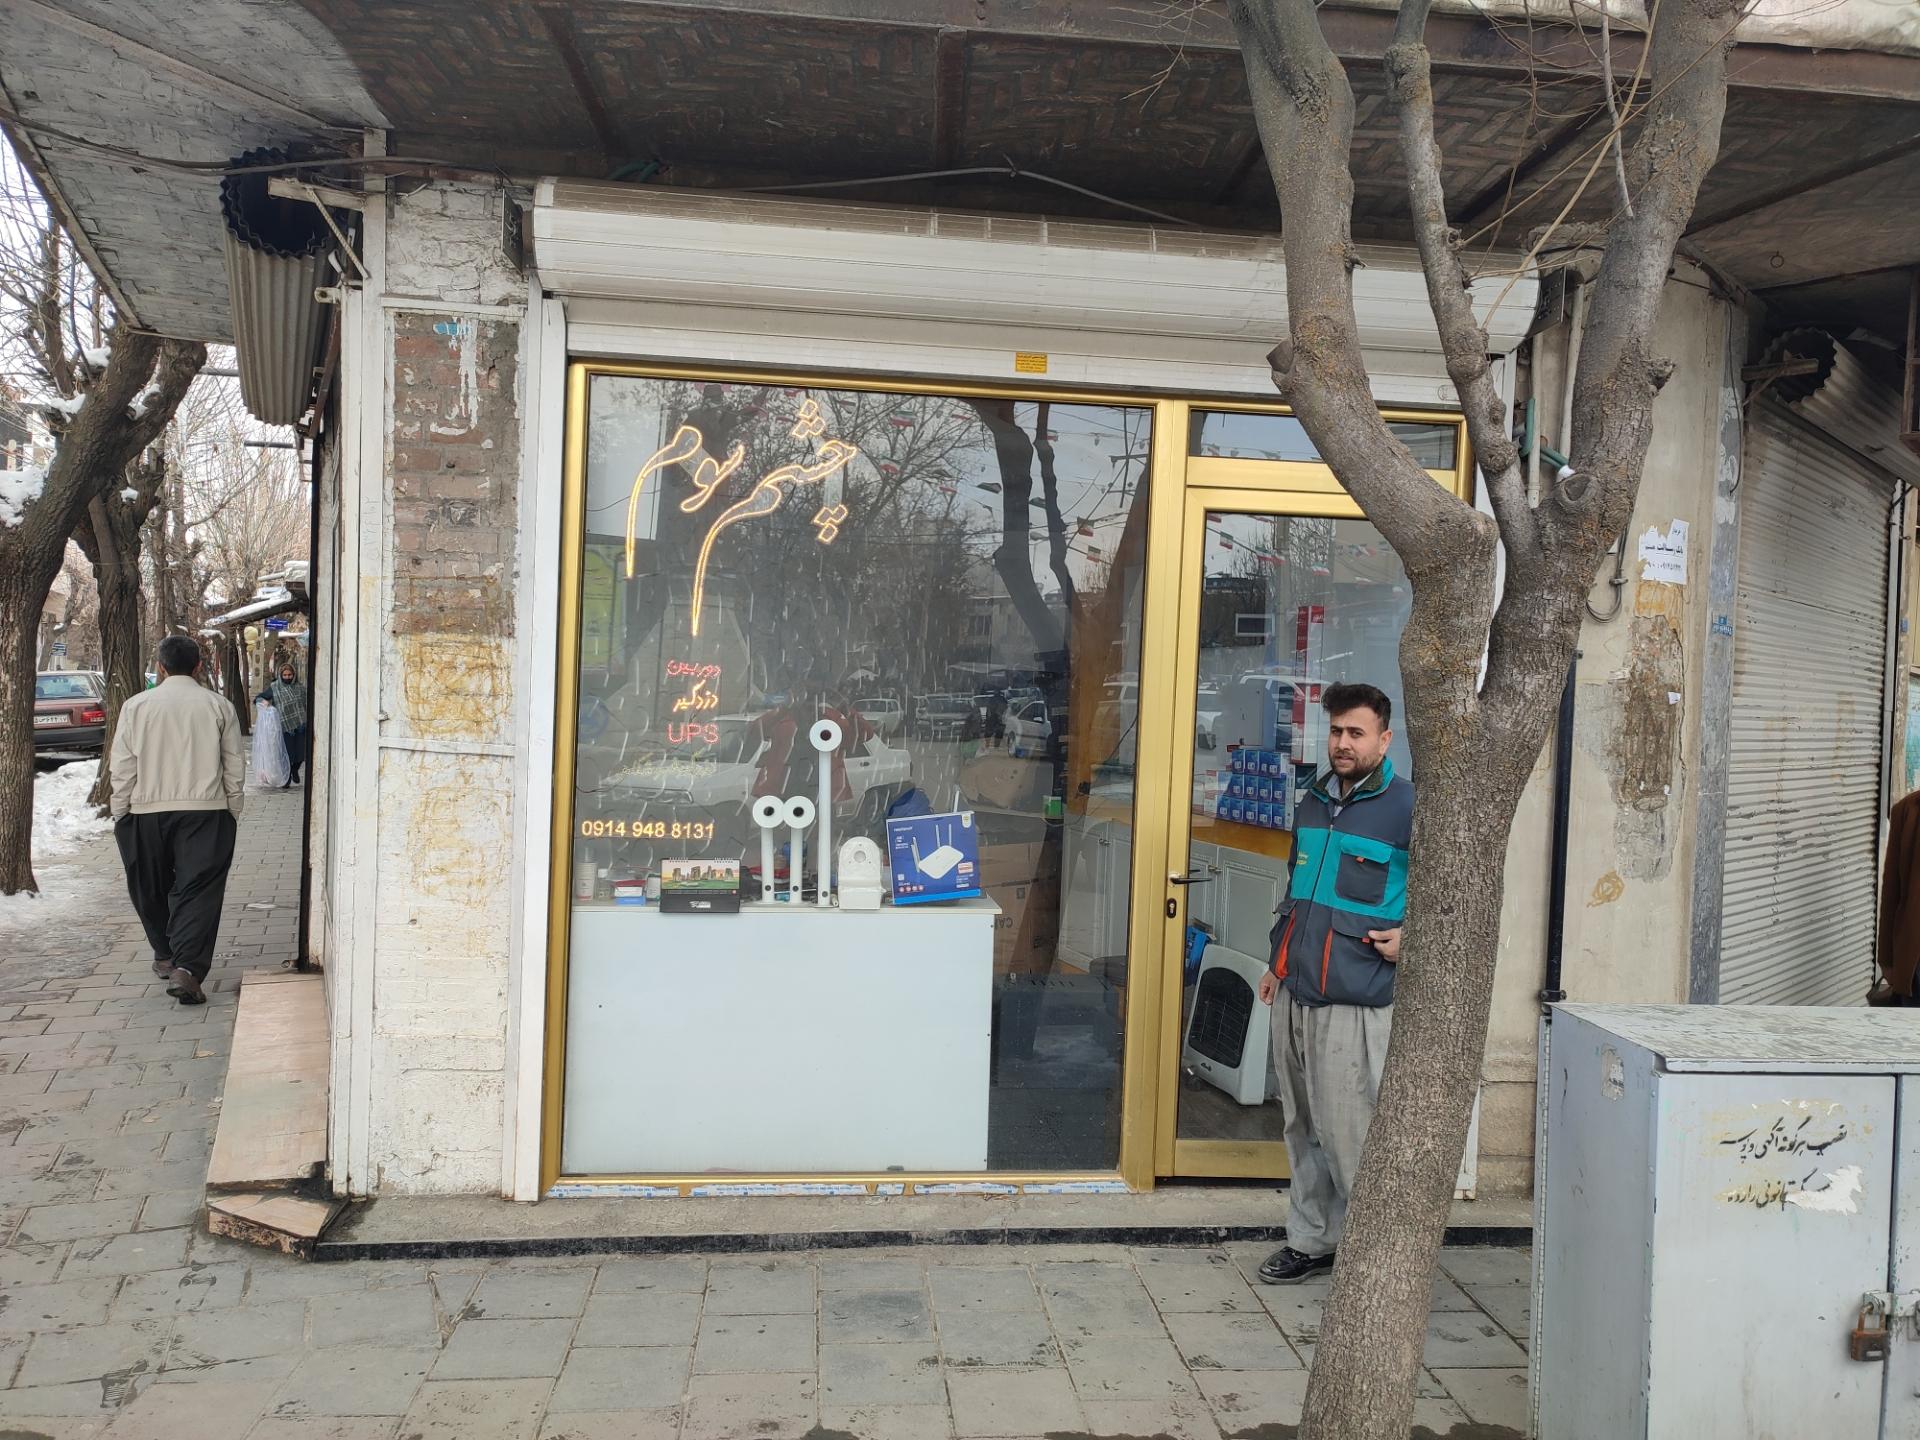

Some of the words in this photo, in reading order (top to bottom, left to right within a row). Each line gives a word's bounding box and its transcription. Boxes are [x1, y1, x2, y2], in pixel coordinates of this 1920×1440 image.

[667, 658, 722, 677] دوربین
[672, 679, 720, 713] دزدگیر
[667, 722, 719, 744] UPS
[581, 819, 627, 838] 0914
[631, 820, 666, 838] 948
[671, 821, 715, 840] 8131
